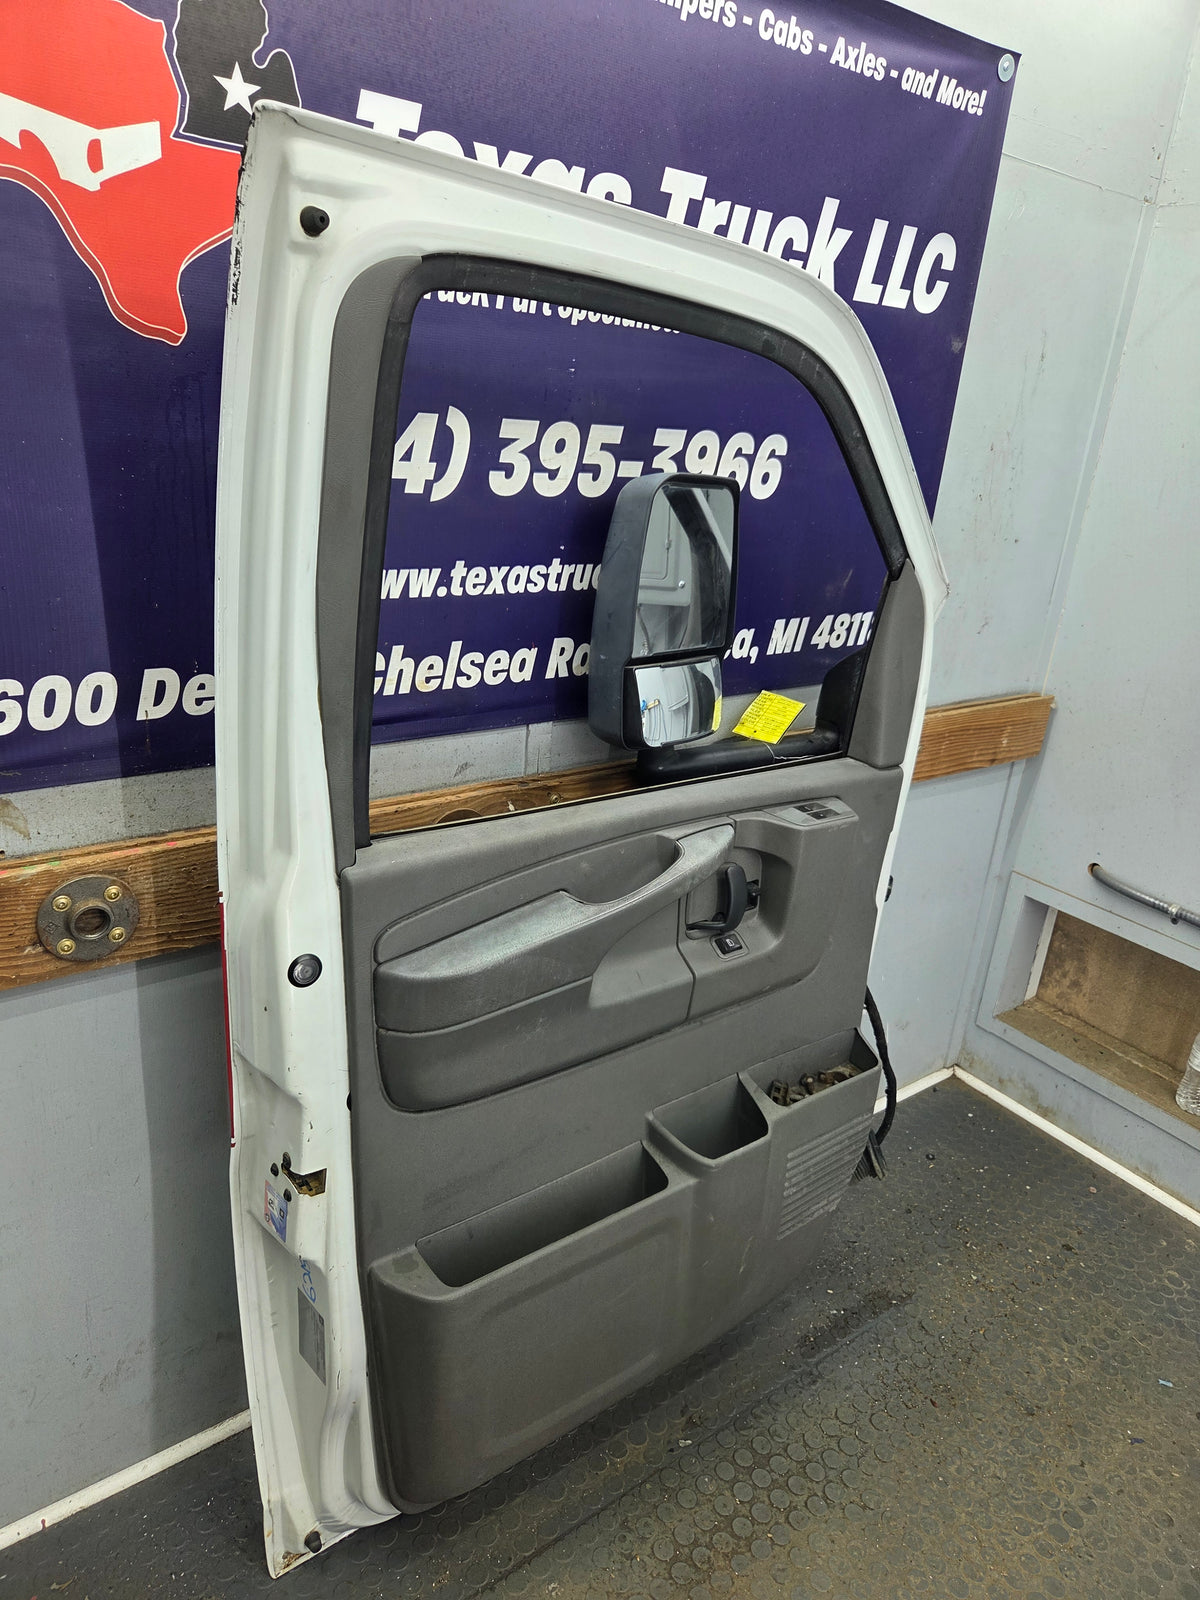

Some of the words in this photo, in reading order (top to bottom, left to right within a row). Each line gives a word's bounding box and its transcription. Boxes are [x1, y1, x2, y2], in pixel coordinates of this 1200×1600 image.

[654, 0, 738, 28] pers
[758, 8, 814, 56] Cabs
[829, 36, 888, 81] Axles
[901, 66, 938, 100] and
[935, 75, 988, 116] More!
[852, 219, 957, 315] LLC
[489, 418, 788, 500] 395-3966
[381, 558, 602, 600] ww.texastru
[766, 616, 810, 656] MI
[810, 611, 875, 650] 4811
